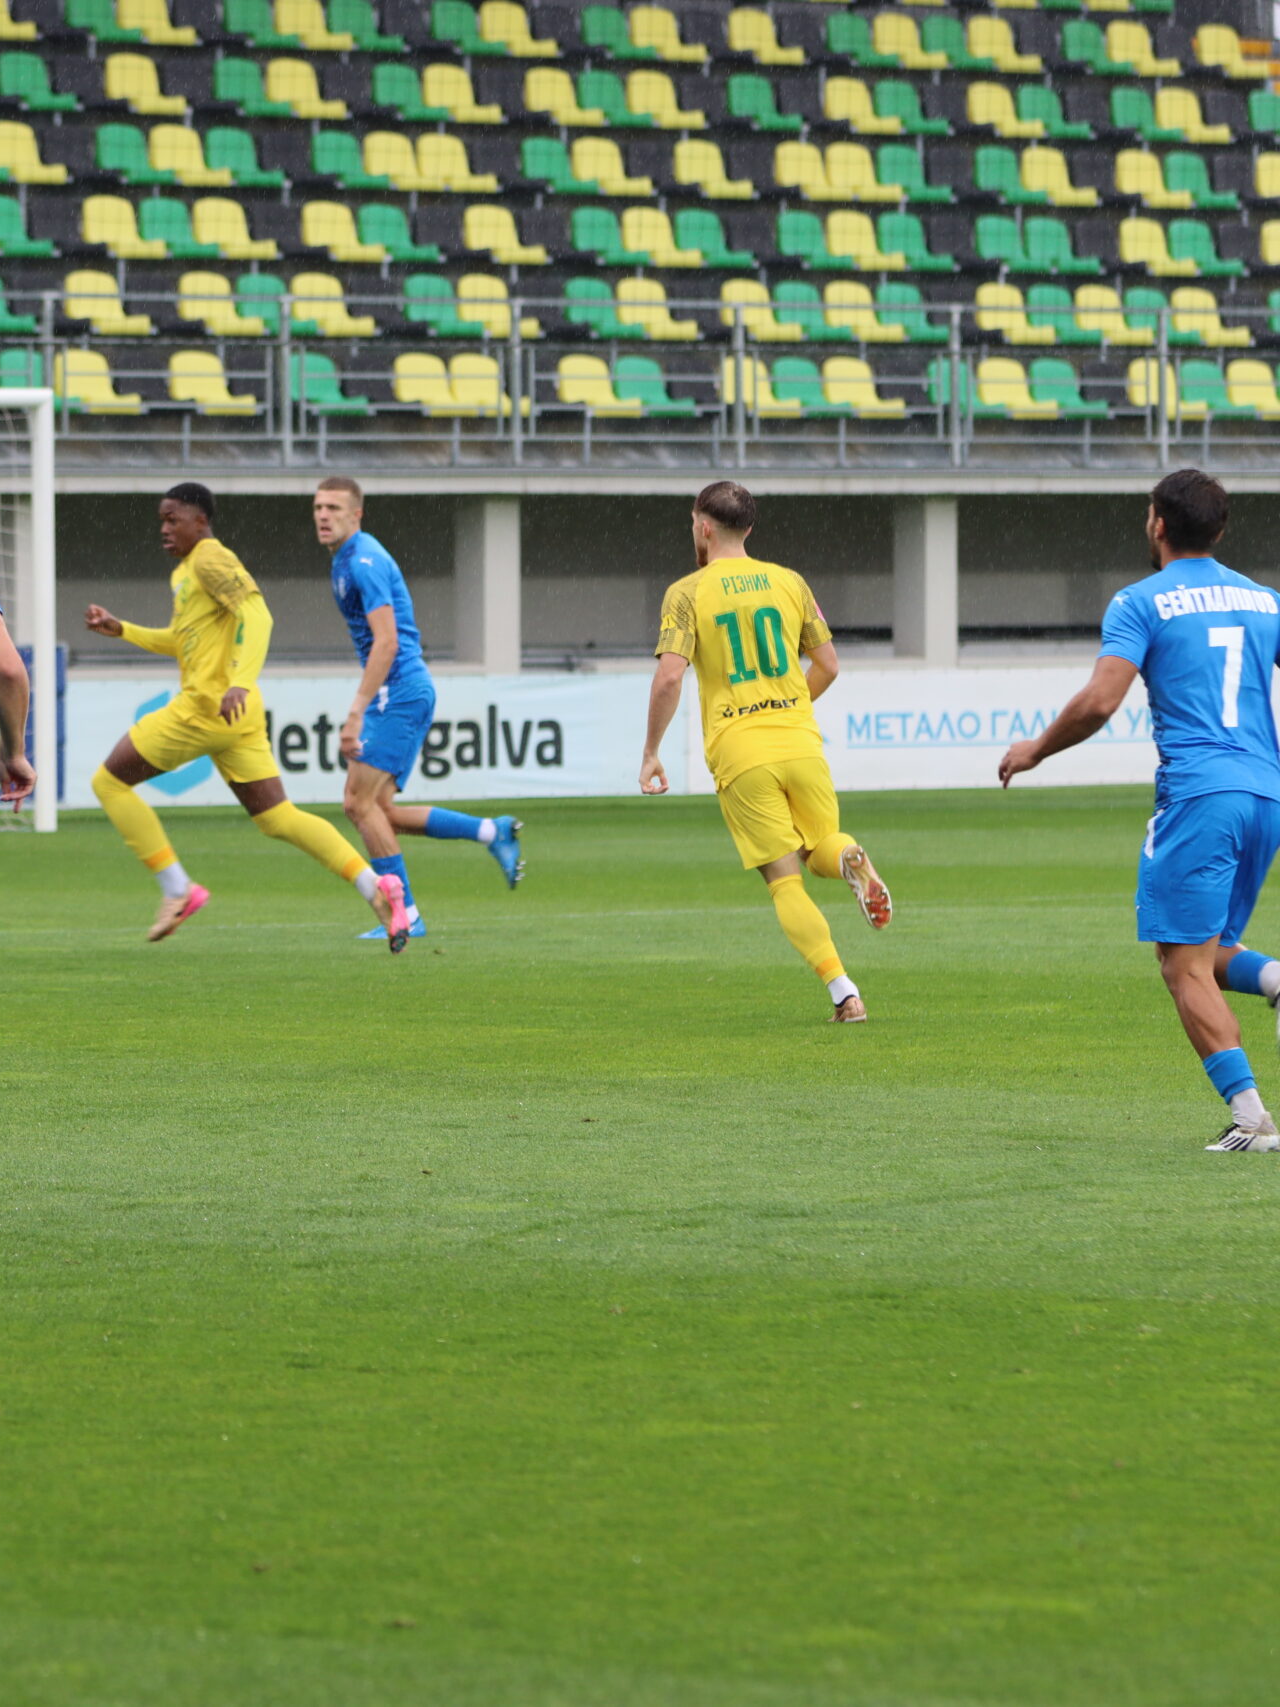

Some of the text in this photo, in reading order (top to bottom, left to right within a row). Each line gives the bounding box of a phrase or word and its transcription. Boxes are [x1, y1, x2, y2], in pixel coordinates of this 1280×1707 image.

[720, 573, 772, 595] РІЗНИК
[714, 606, 789, 685] 10
[1208, 626, 1245, 728] 7
[738, 697, 799, 716] FAVBET
[846, 711, 982, 741] МЕТАЛО
